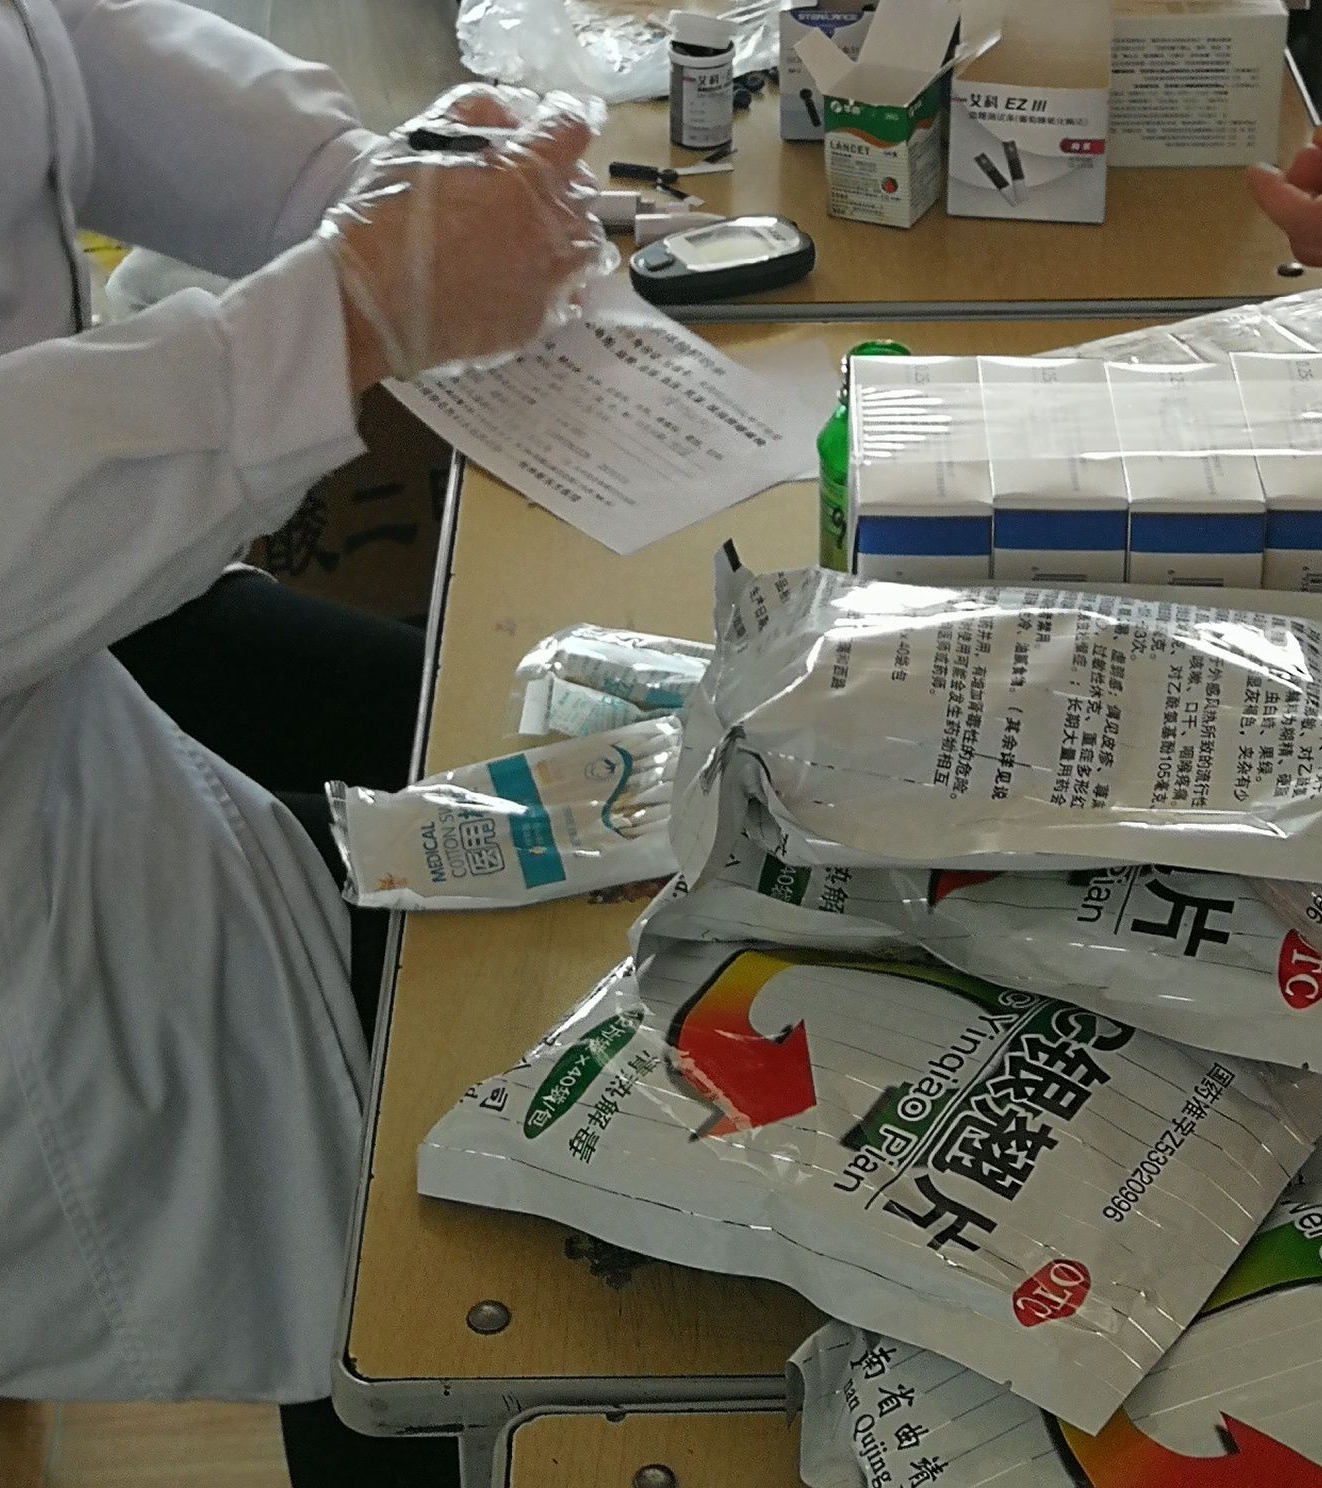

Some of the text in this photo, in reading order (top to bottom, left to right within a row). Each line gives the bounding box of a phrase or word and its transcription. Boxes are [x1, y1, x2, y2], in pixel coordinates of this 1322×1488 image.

[1005, 97, 1028, 111] EZ
[421, 821, 447, 883] MEDICAL
[441, 826, 466, 878] COTTON
[897, 1012, 1018, 1121] Yinqiao
[569, 1050, 661, 1165] 清热解毒
[834, 1125, 918, 1193] Pian
[1102, 1062, 1236, 1223] 国药准字Z53020996
[1016, 1262, 1086, 1320] OTC
[853, 1414, 892, 1488] Qujing
